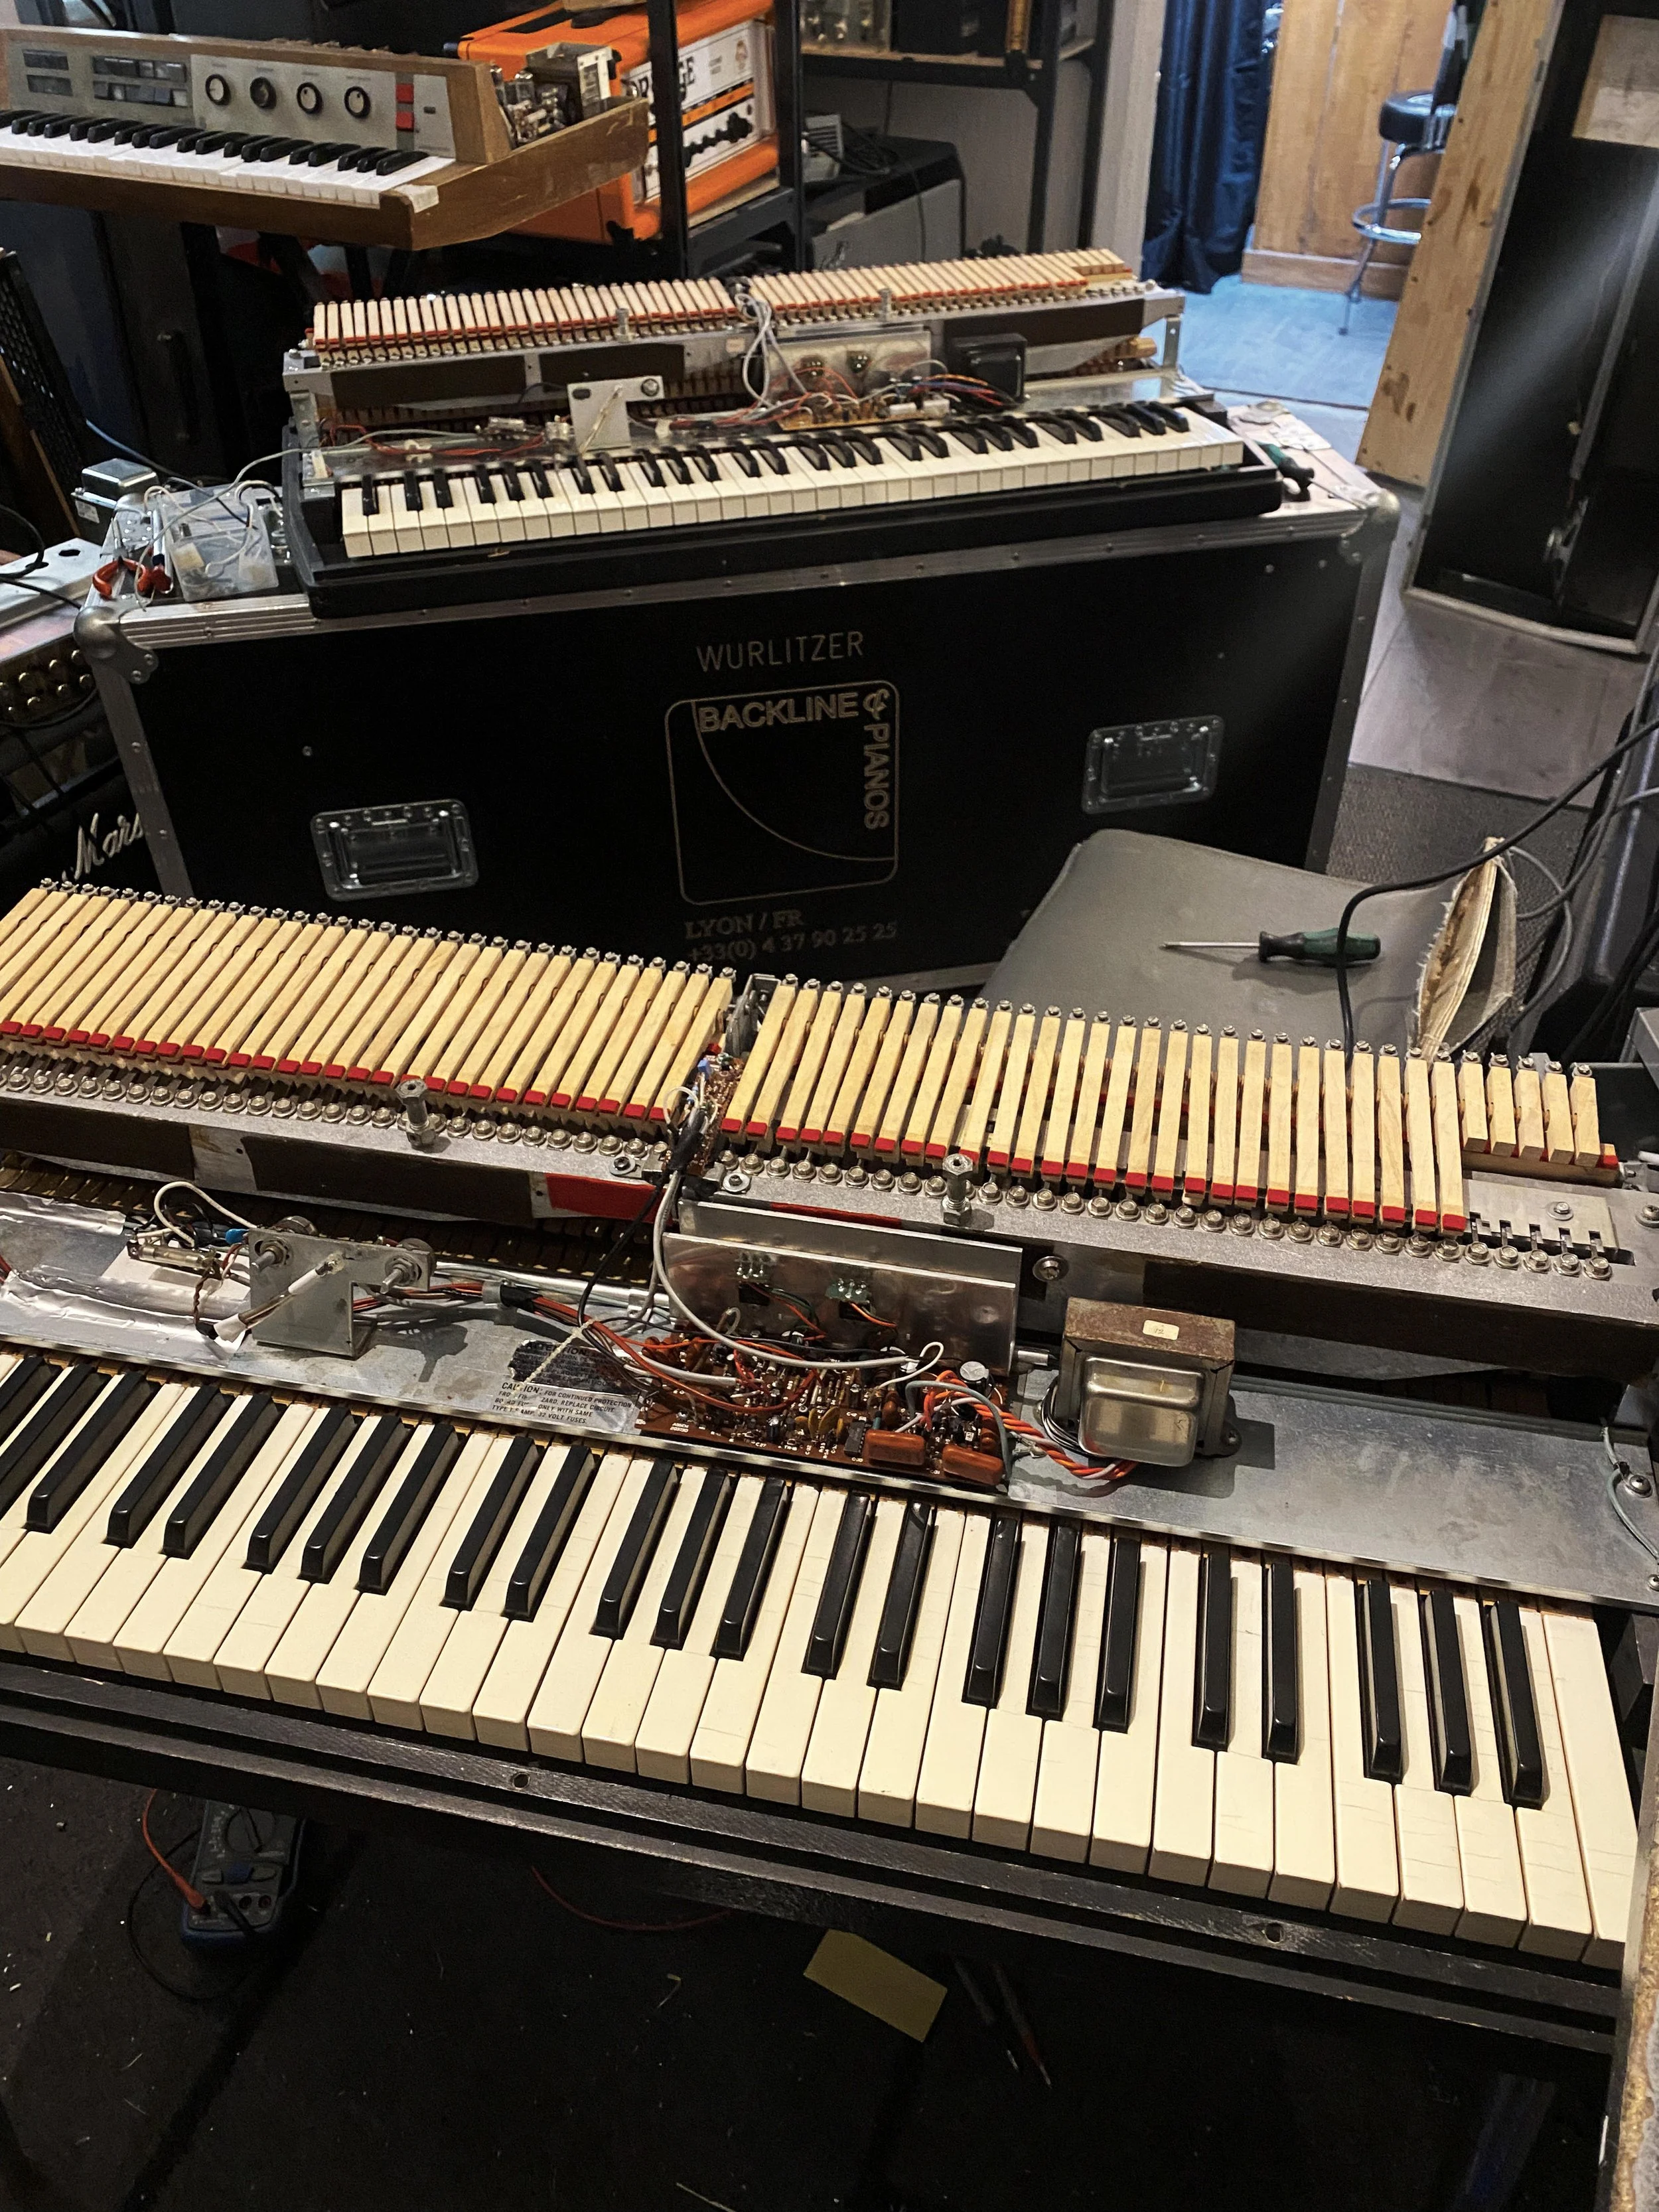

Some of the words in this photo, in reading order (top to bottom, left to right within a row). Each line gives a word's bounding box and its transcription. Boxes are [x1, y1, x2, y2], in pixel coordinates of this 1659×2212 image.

[697, 630, 863, 672] WURLITZER
[697, 692, 859, 733] BACKLINE
[863, 688, 890, 720] &
[864, 723, 890, 830] PIANOS
[684, 913, 755, 940] LYON
[772, 909, 804, 929] FR
[687, 938, 757, 962] +33(0)
[762, 936, 775, 954] 4
[780, 933, 805, 952] 37
[811, 928, 836, 948] 90
[842, 925, 867, 945] 25
[873, 921, 897, 941] 25
[502, 1382, 543, 1394] CAUION:
[558, 1392, 593, 1402] CONTINUED
[593, 1398, 632, 1408] PROTECTION
[561, 1400, 588, 1409] REPLACE
[589, 1404, 614, 1413] CIRCUIT
[575, 1409, 593, 1418] SAME
